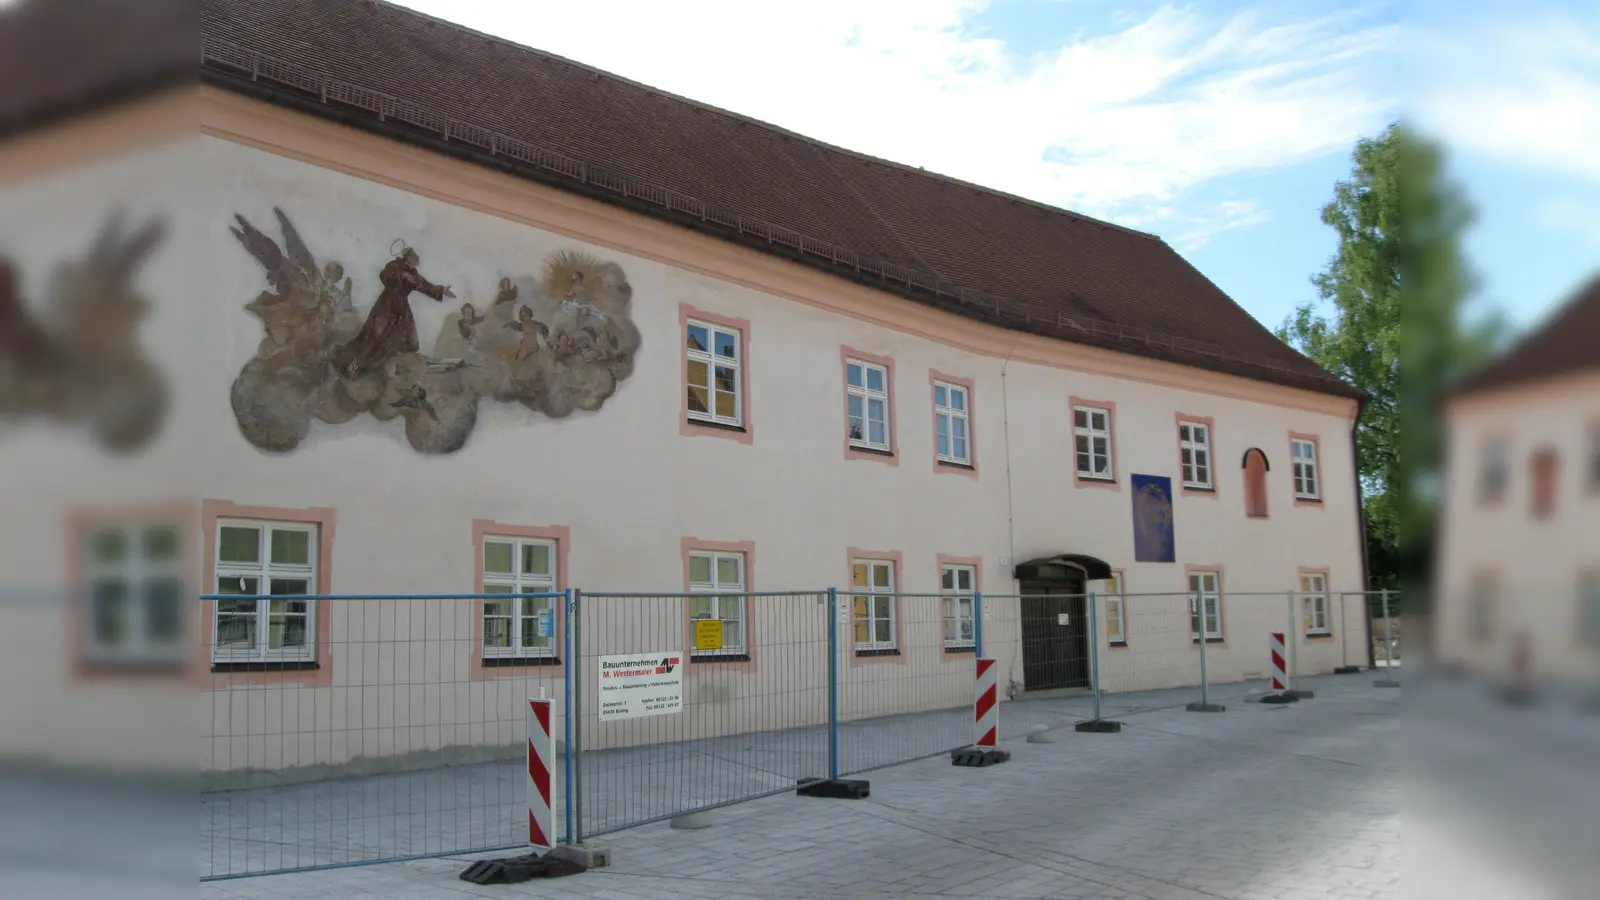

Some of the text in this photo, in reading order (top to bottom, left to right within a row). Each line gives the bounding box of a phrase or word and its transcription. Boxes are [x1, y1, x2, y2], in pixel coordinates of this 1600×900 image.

[602, 659, 658, 668] Bauunternehmen
[602, 669, 652, 679] M. Westermaier
